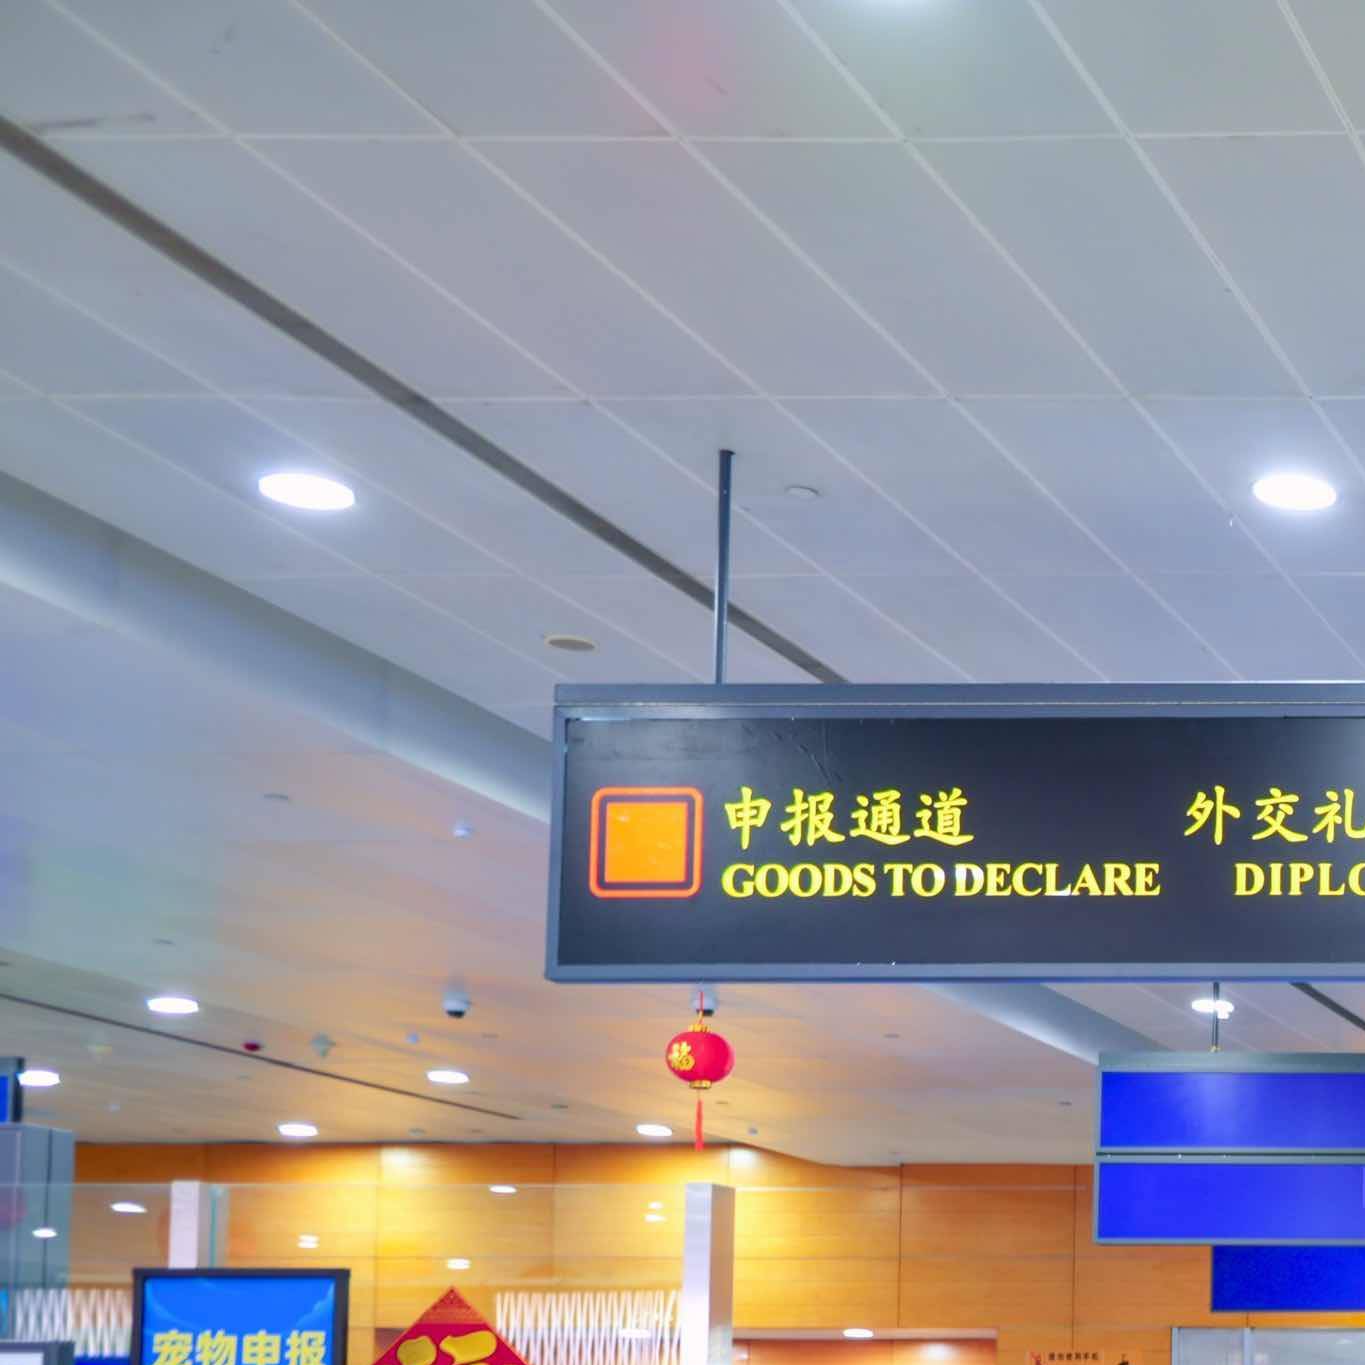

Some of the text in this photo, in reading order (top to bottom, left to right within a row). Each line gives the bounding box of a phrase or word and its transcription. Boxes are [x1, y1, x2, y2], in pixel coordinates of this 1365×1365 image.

[724, 787, 975, 850] 申报通道
[722, 862, 1161, 898] GOODS TO DECLARE
